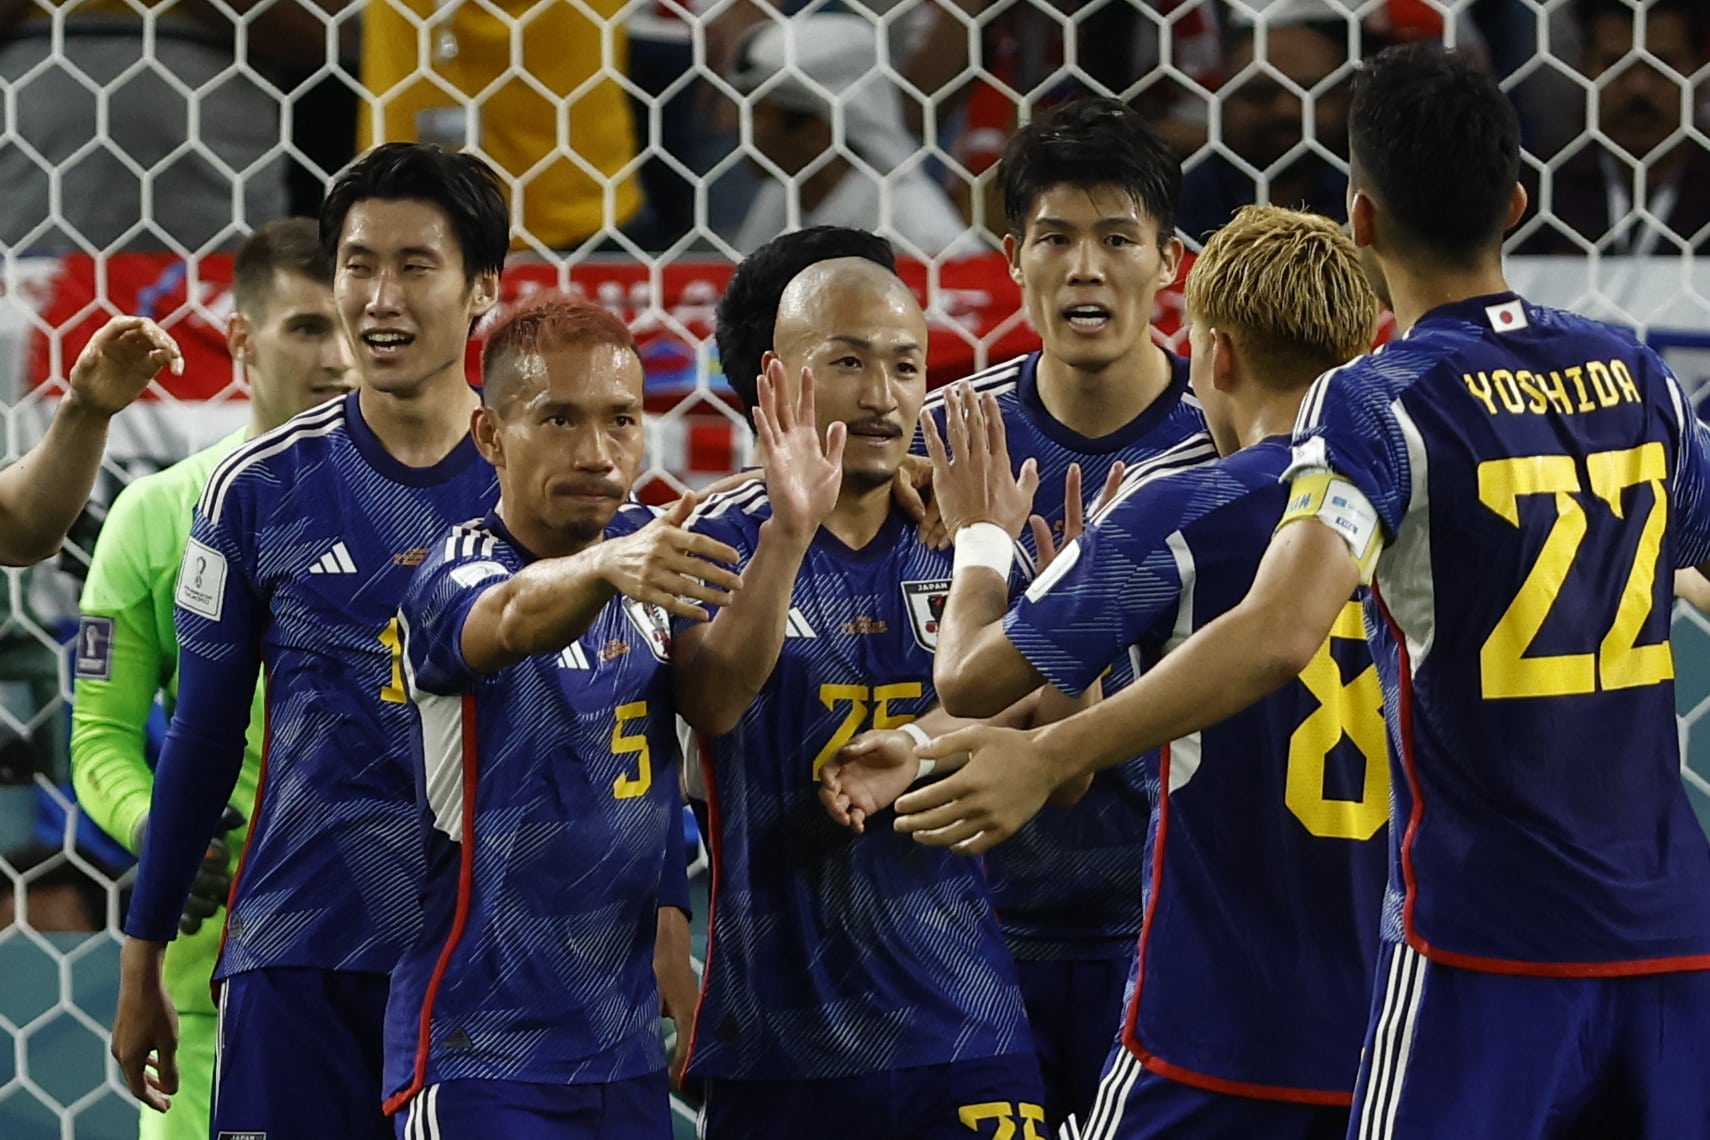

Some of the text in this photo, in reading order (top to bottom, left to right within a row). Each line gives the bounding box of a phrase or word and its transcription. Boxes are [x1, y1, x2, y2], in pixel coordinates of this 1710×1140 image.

[1463, 359, 1642, 415] YOSHIDA
[918, 582, 948, 591] JAPAN
[1477, 441, 1675, 699] 22
[611, 700, 652, 799] 5
[1285, 600, 1393, 841] 8
